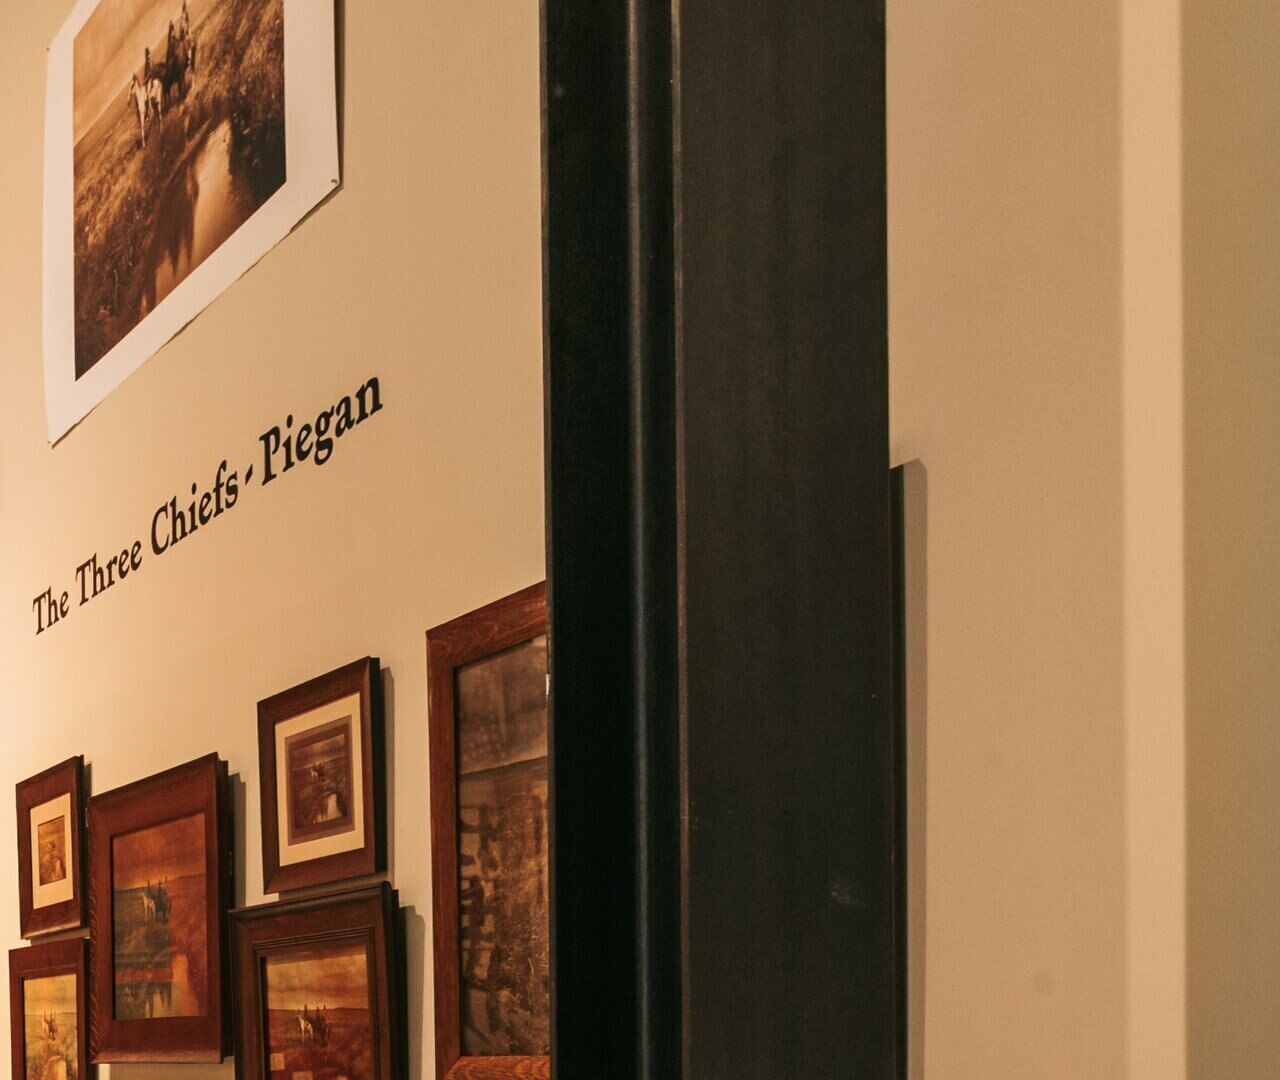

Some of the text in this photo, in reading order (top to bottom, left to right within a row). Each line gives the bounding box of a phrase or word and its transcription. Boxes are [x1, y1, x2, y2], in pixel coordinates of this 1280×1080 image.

[32, 586, 69, 636] The
[76, 540, 142, 607] Three
[151, 460, 238, 556] Chiefs
[259, 376, 383, 486] Piegan
